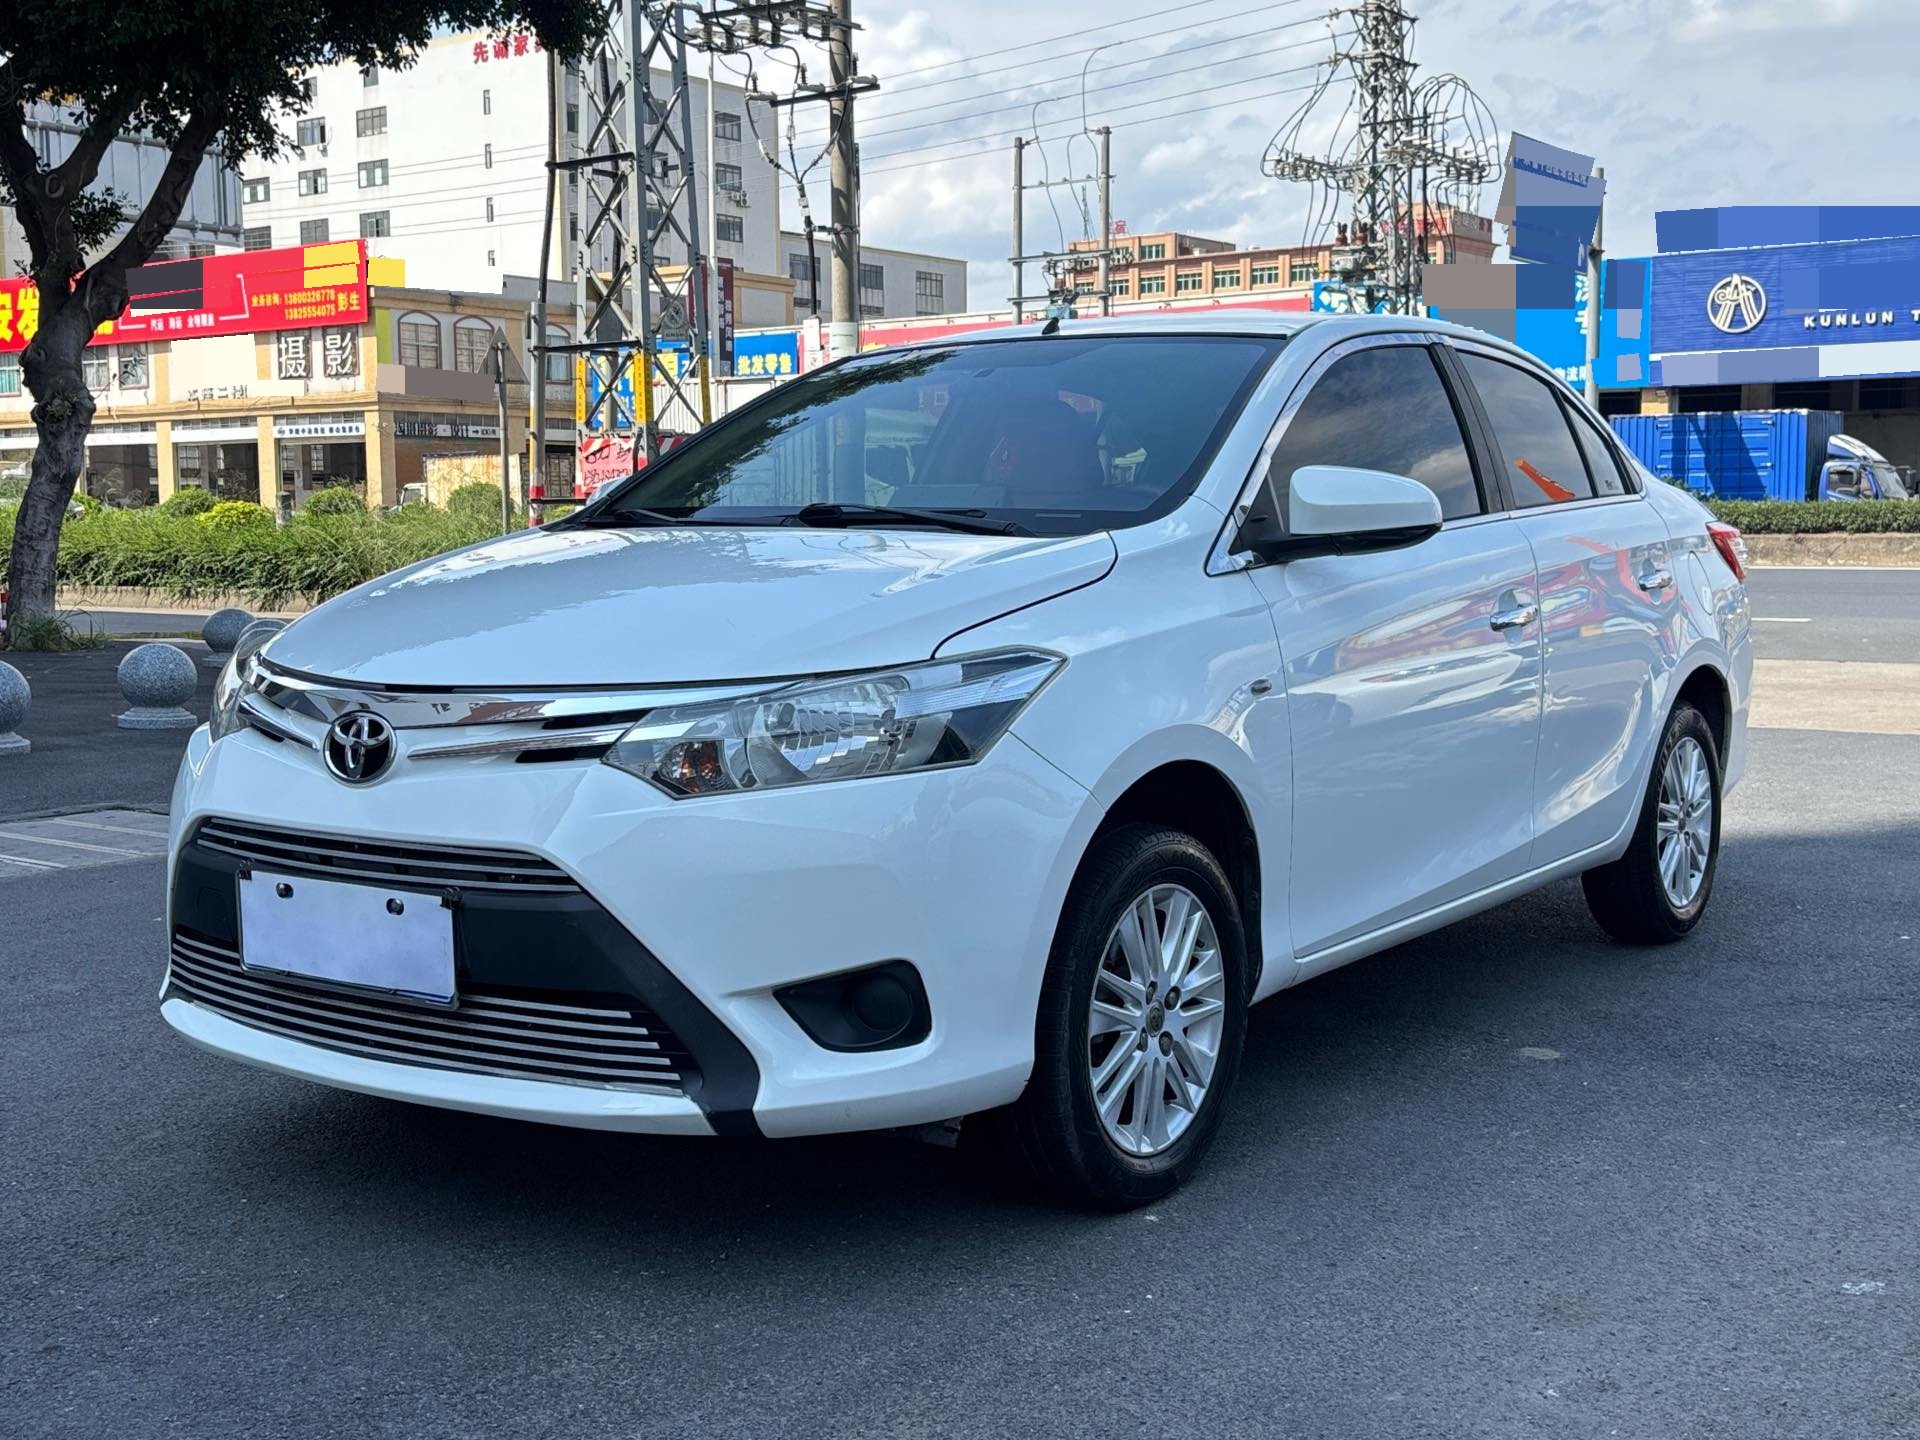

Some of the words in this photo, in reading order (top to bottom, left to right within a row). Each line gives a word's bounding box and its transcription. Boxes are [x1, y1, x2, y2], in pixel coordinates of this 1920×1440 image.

[1804, 310, 1894, 328] KUNLUN
[279, 332, 352, 378] 摄影
[738, 352, 792, 376] 批发零售
